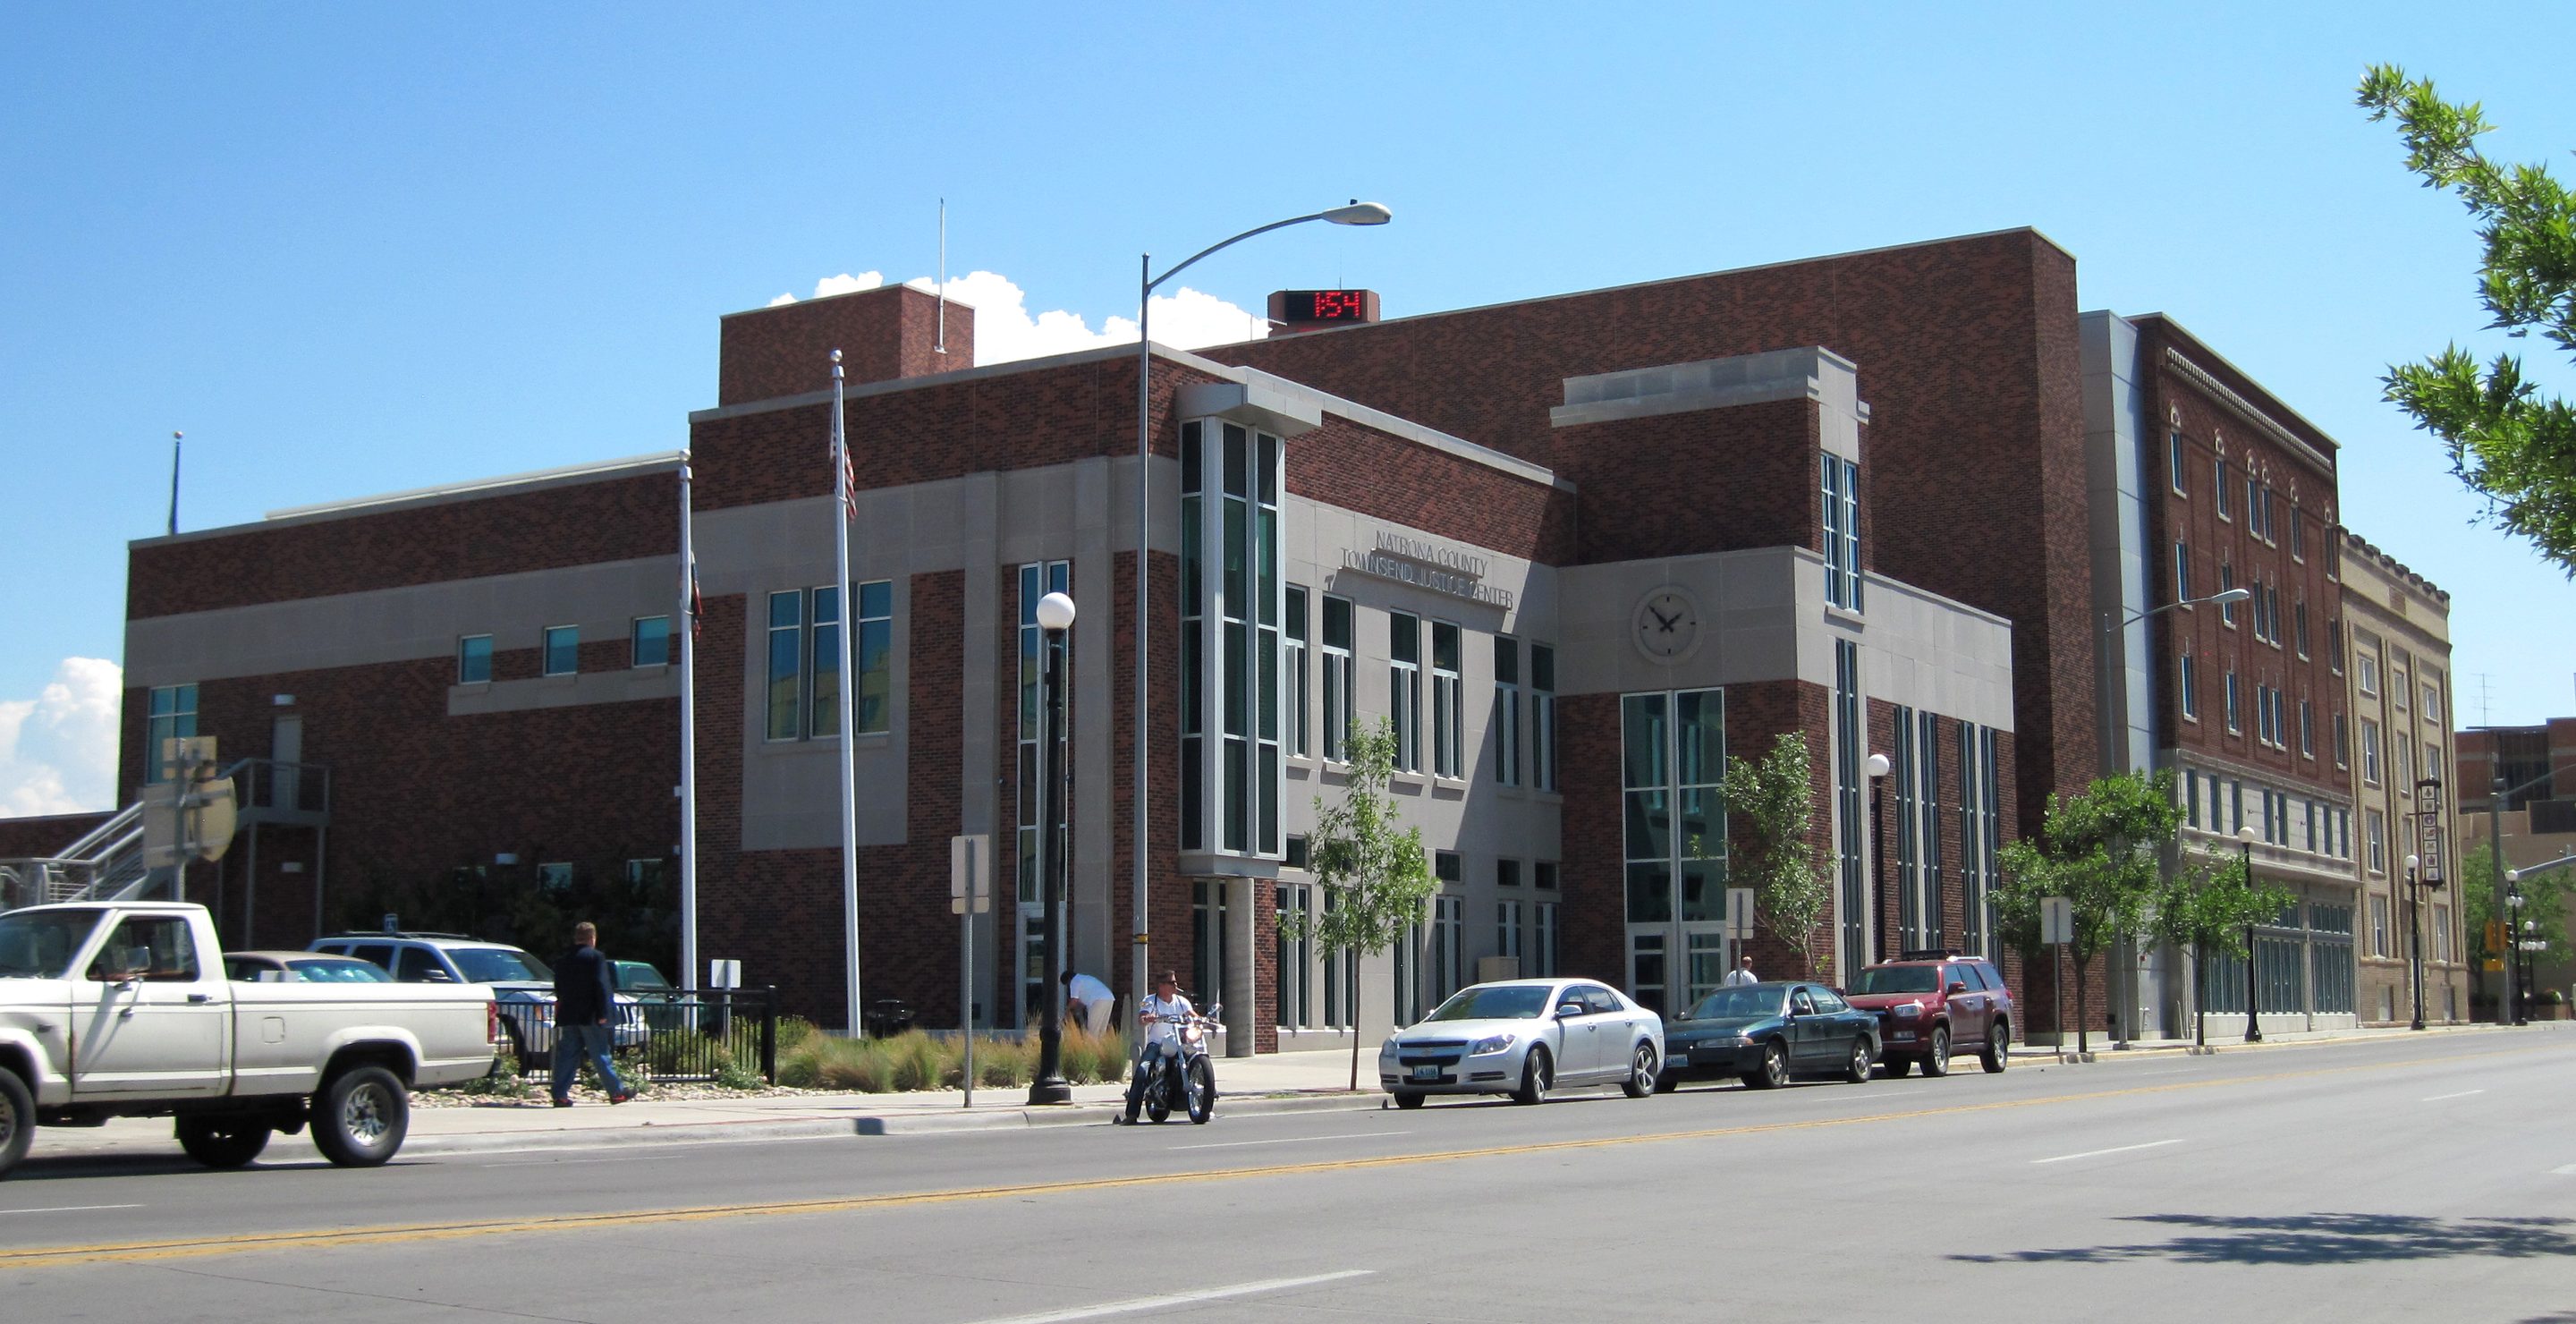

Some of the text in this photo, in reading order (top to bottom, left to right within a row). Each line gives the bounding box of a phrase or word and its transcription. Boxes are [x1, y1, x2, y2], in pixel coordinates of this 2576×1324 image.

[1315, 291, 1360, 318] 1:54
[1376, 530, 1487, 576] NATRONA COUNTY
[1341, 547, 1513, 609] TOWNSEND JUSTICE CENTER
